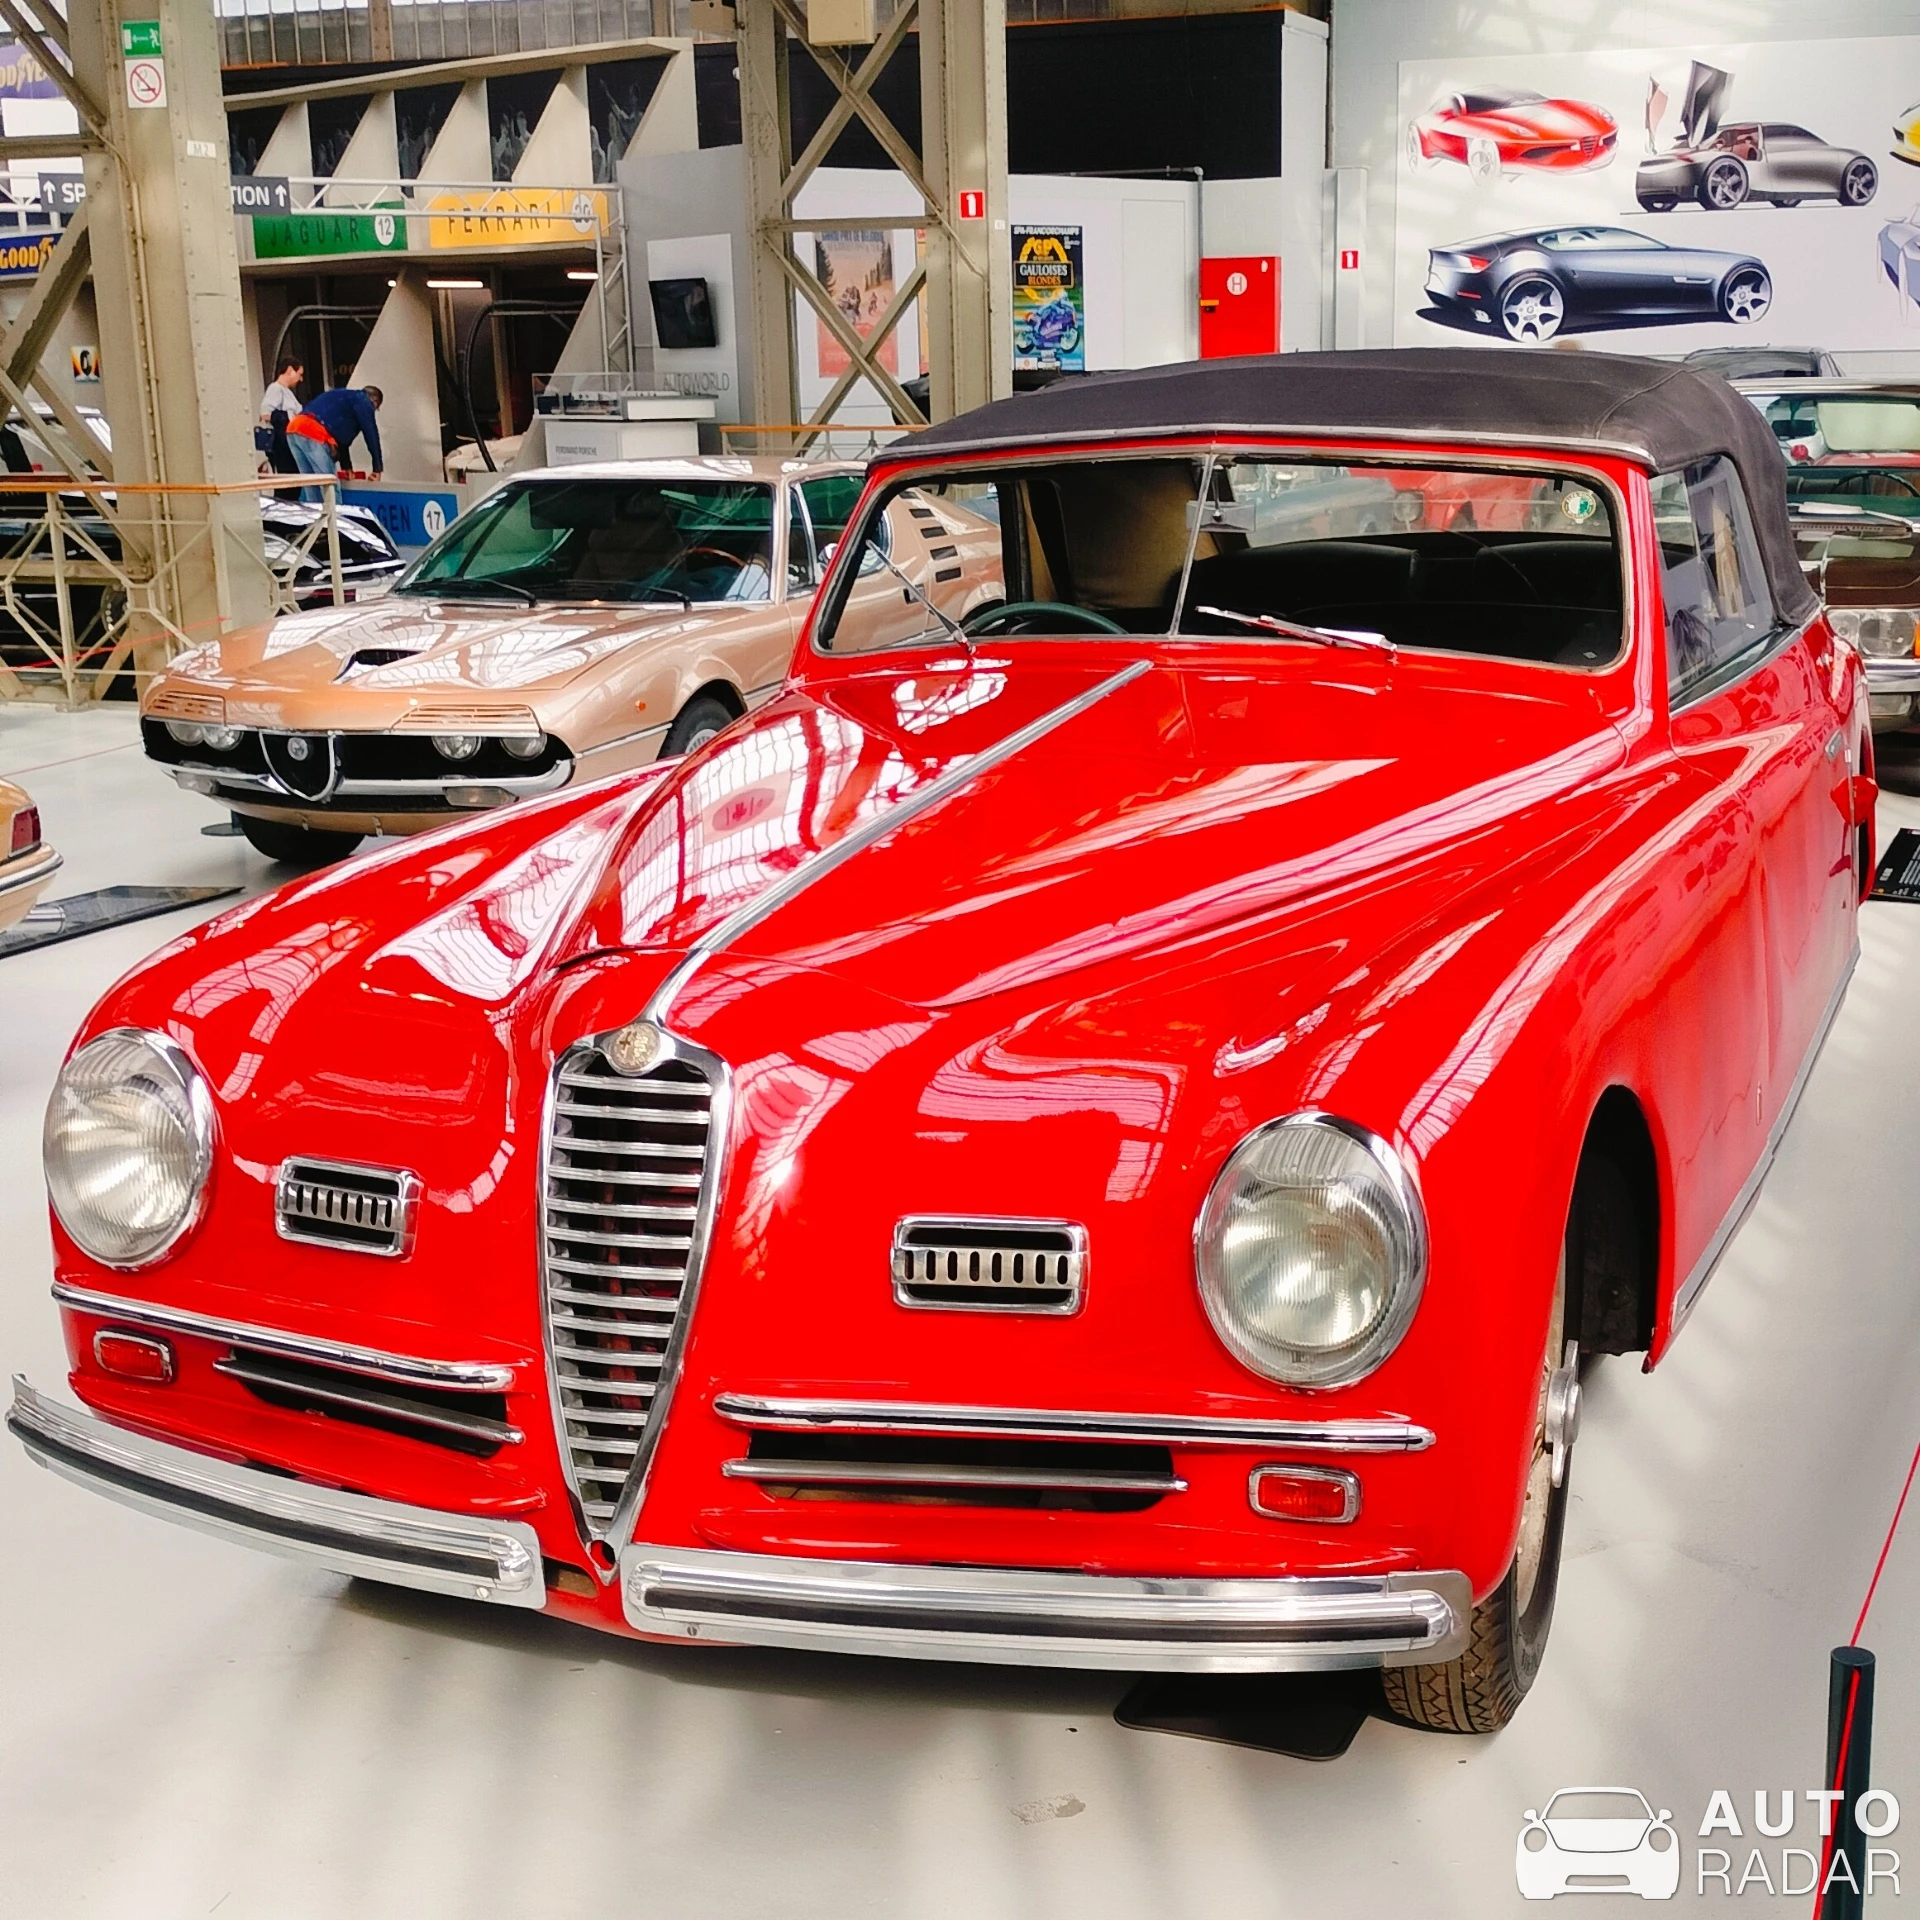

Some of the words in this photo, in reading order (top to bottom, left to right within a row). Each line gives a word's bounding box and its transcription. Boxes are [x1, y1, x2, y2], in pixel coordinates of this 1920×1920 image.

[378, 217, 392, 236] 12
[448, 201, 551, 234] FERRARI
[271, 218, 359, 247] JAGUAR
[1020, 264, 1068, 276] GAULOISES
[1028, 276, 1061, 285] BLONDES
[426, 511, 441, 531] 17
